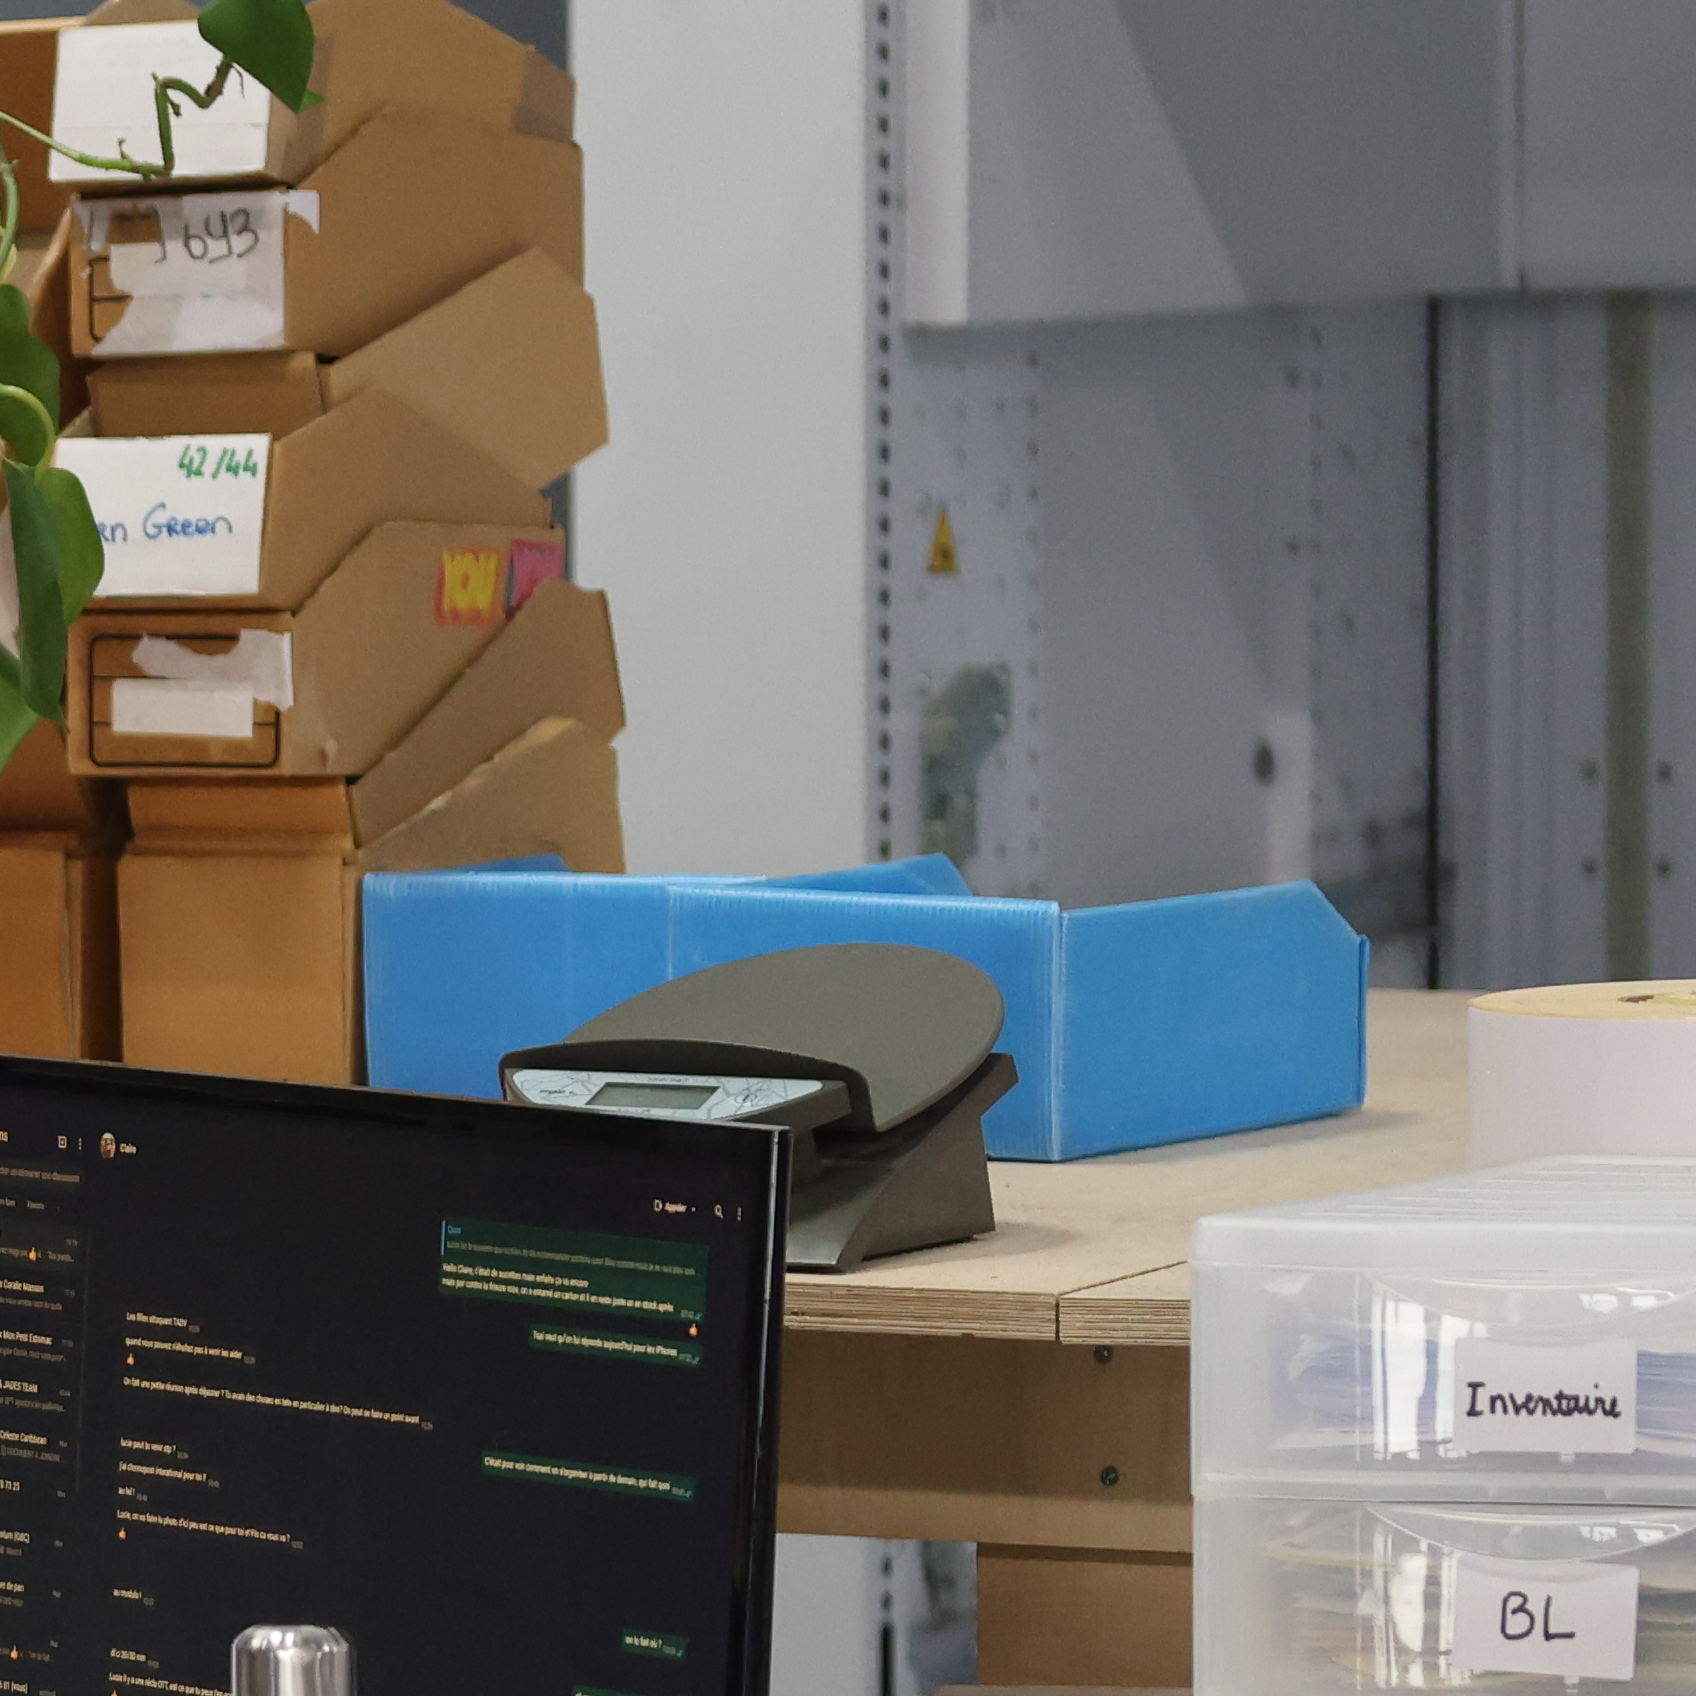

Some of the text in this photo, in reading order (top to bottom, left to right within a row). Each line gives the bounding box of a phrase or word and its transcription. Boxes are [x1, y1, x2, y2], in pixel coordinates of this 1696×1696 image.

[178, 445, 257, 479] 42/44
[1467, 1381, 1621, 1418] Inventaire
[1501, 1591, 1575, 1641] BL
